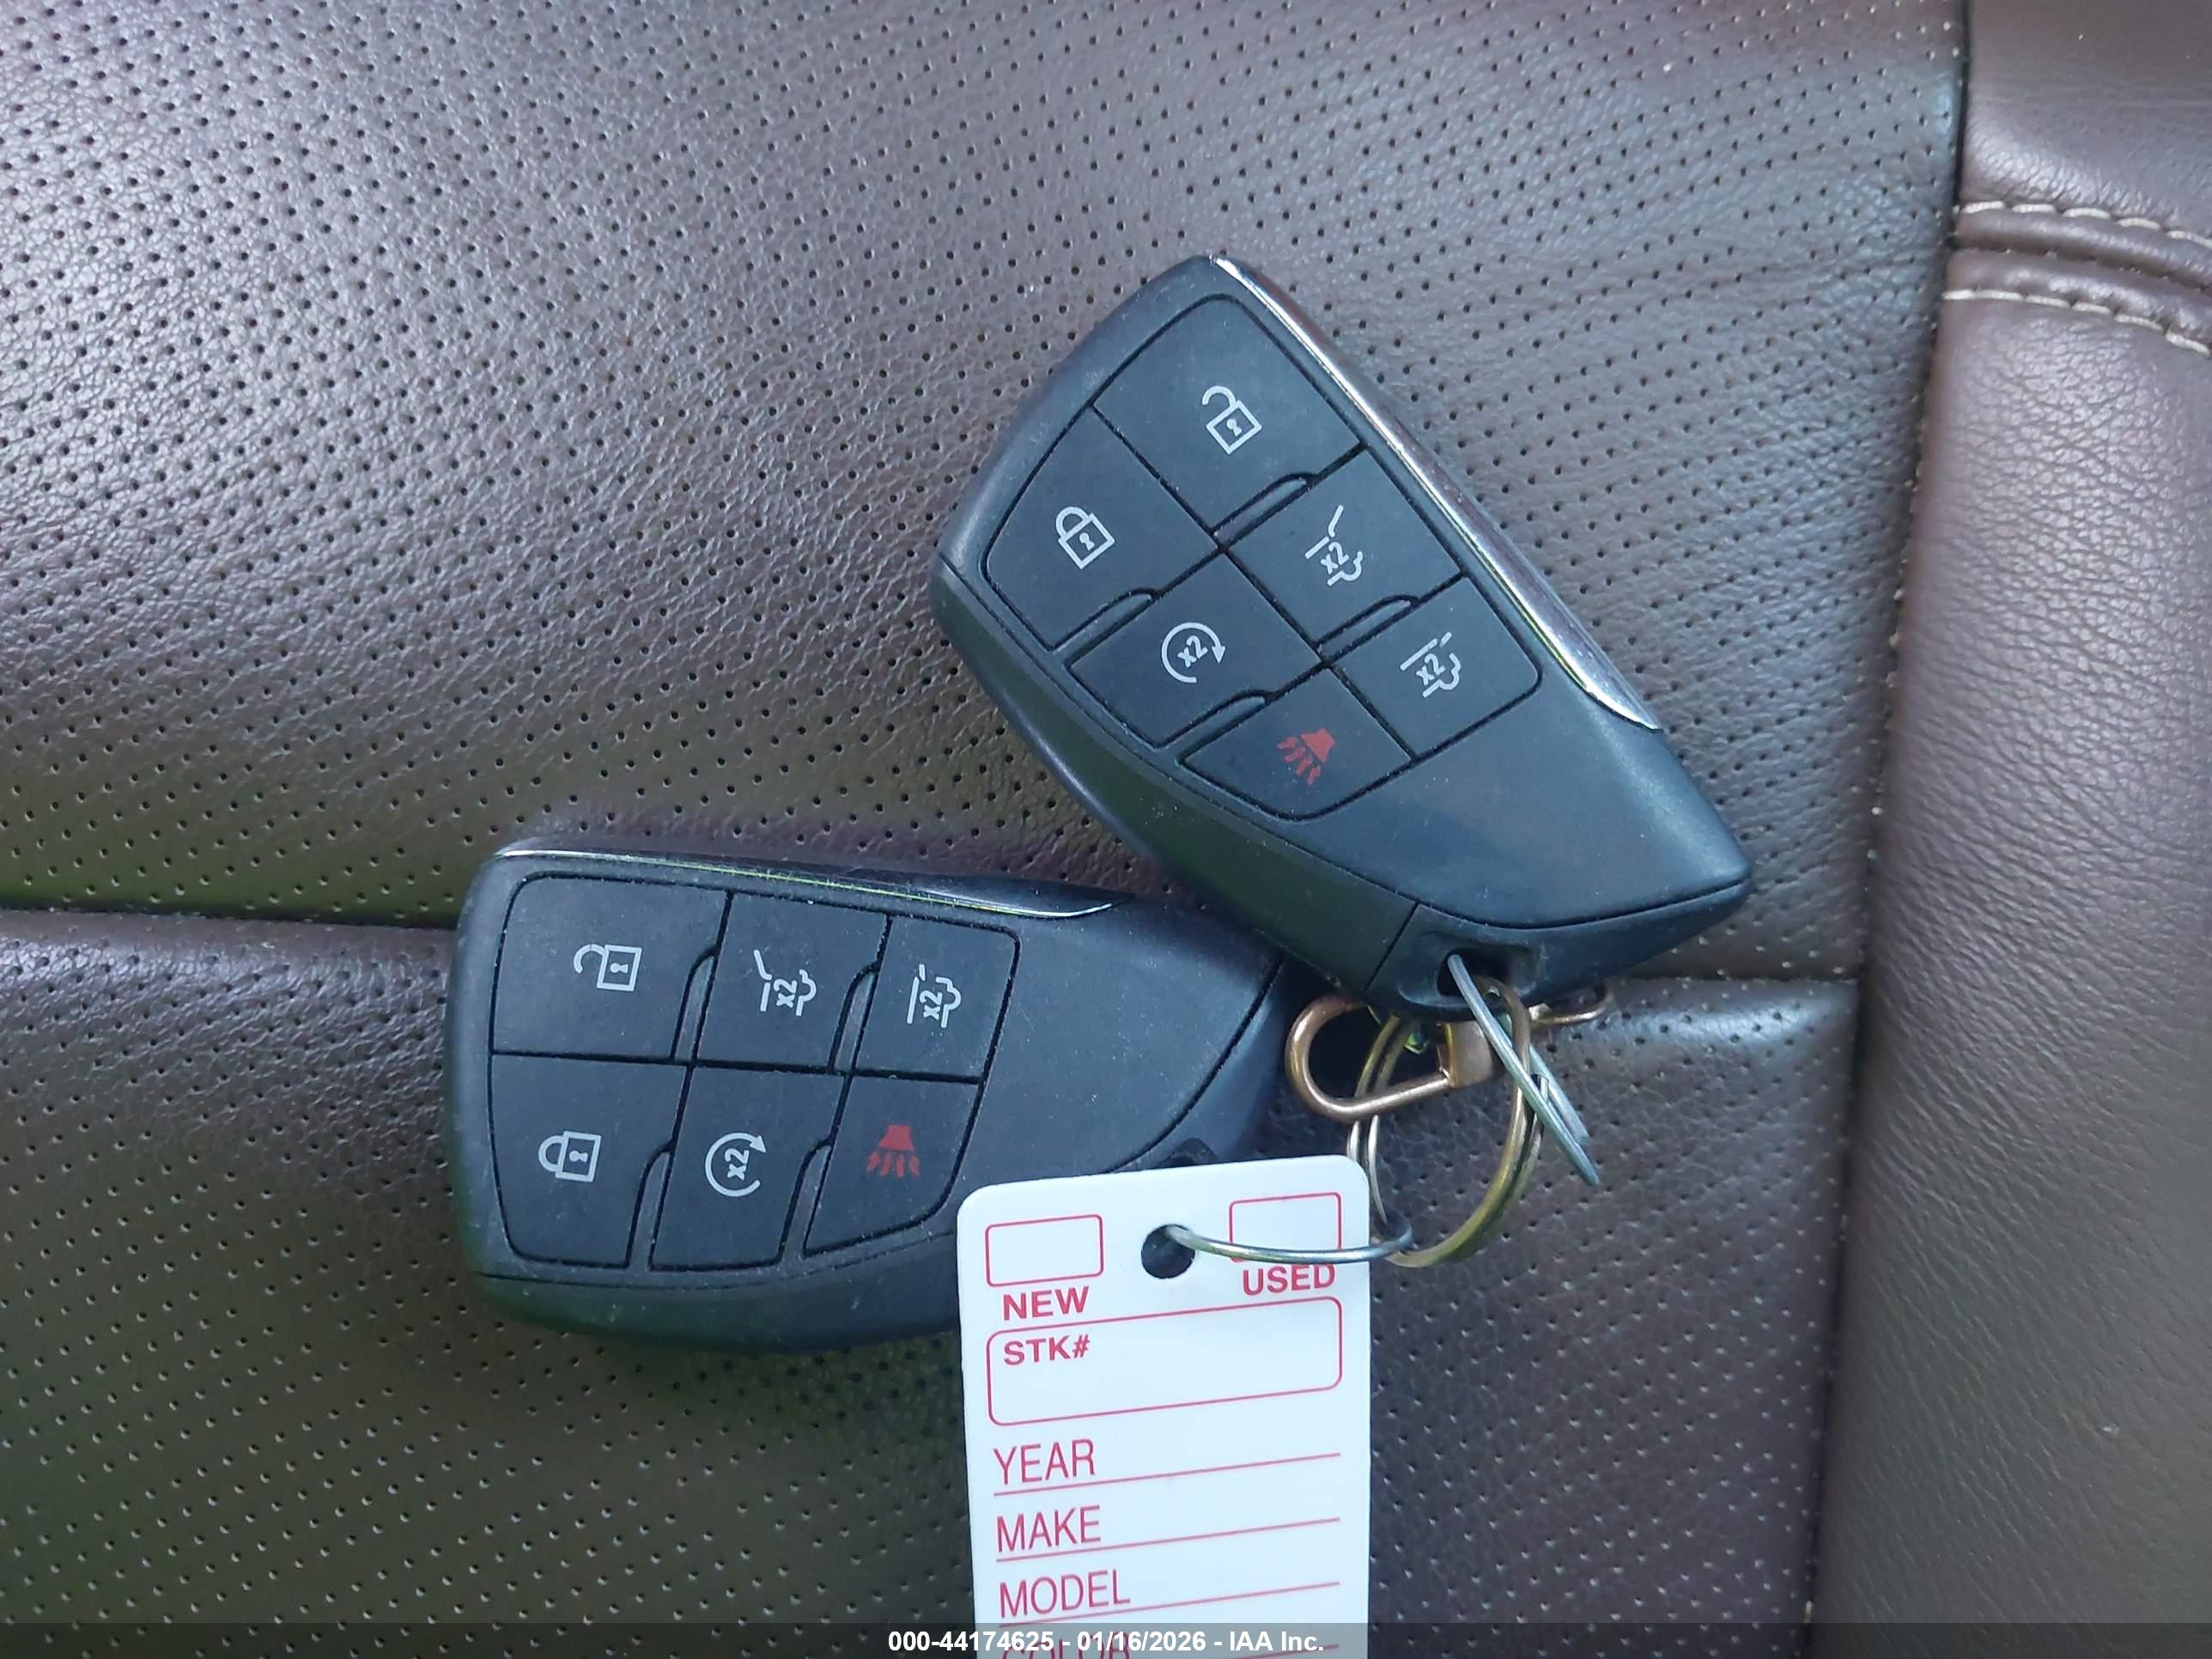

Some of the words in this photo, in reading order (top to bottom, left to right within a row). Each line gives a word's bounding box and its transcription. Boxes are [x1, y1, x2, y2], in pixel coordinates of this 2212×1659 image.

[1321, 542, 1349, 574] x2
[1177, 635, 1208, 667] x2
[1416, 653, 1446, 686] x2
[774, 979, 798, 1008] x2
[920, 989, 943, 1020] x2
[725, 1148, 750, 1181] x2
[1242, 1264, 1336, 1296] USED
[1002, 1285, 1090, 1321] NEW
[1003, 1334, 1091, 1366] STK#
[994, 1438, 1096, 1486] YEAR
[996, 1505, 1102, 1553] MAKE
[999, 1570, 1131, 1619] MODEL
